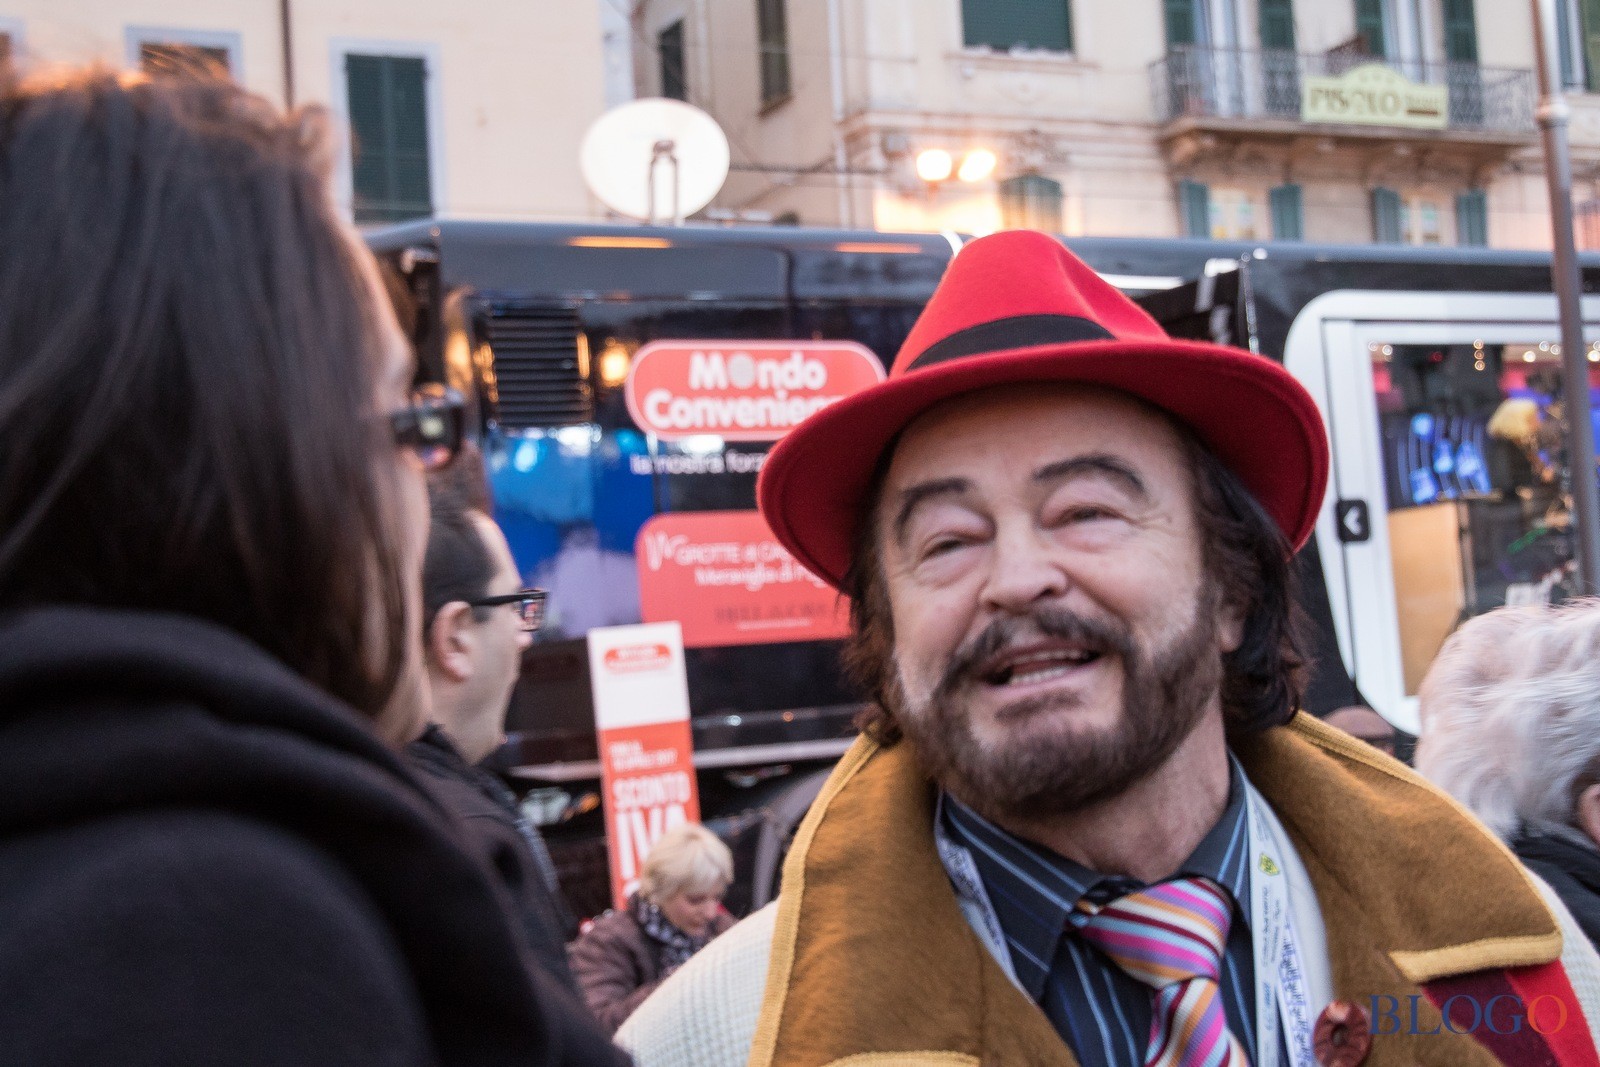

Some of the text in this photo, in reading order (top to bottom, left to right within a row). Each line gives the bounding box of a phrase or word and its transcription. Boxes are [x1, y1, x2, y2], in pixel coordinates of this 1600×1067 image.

[688, 352, 828, 390] Mondo
[643, 389, 842, 428] Convenie
[725, 449, 769, 473] forz
